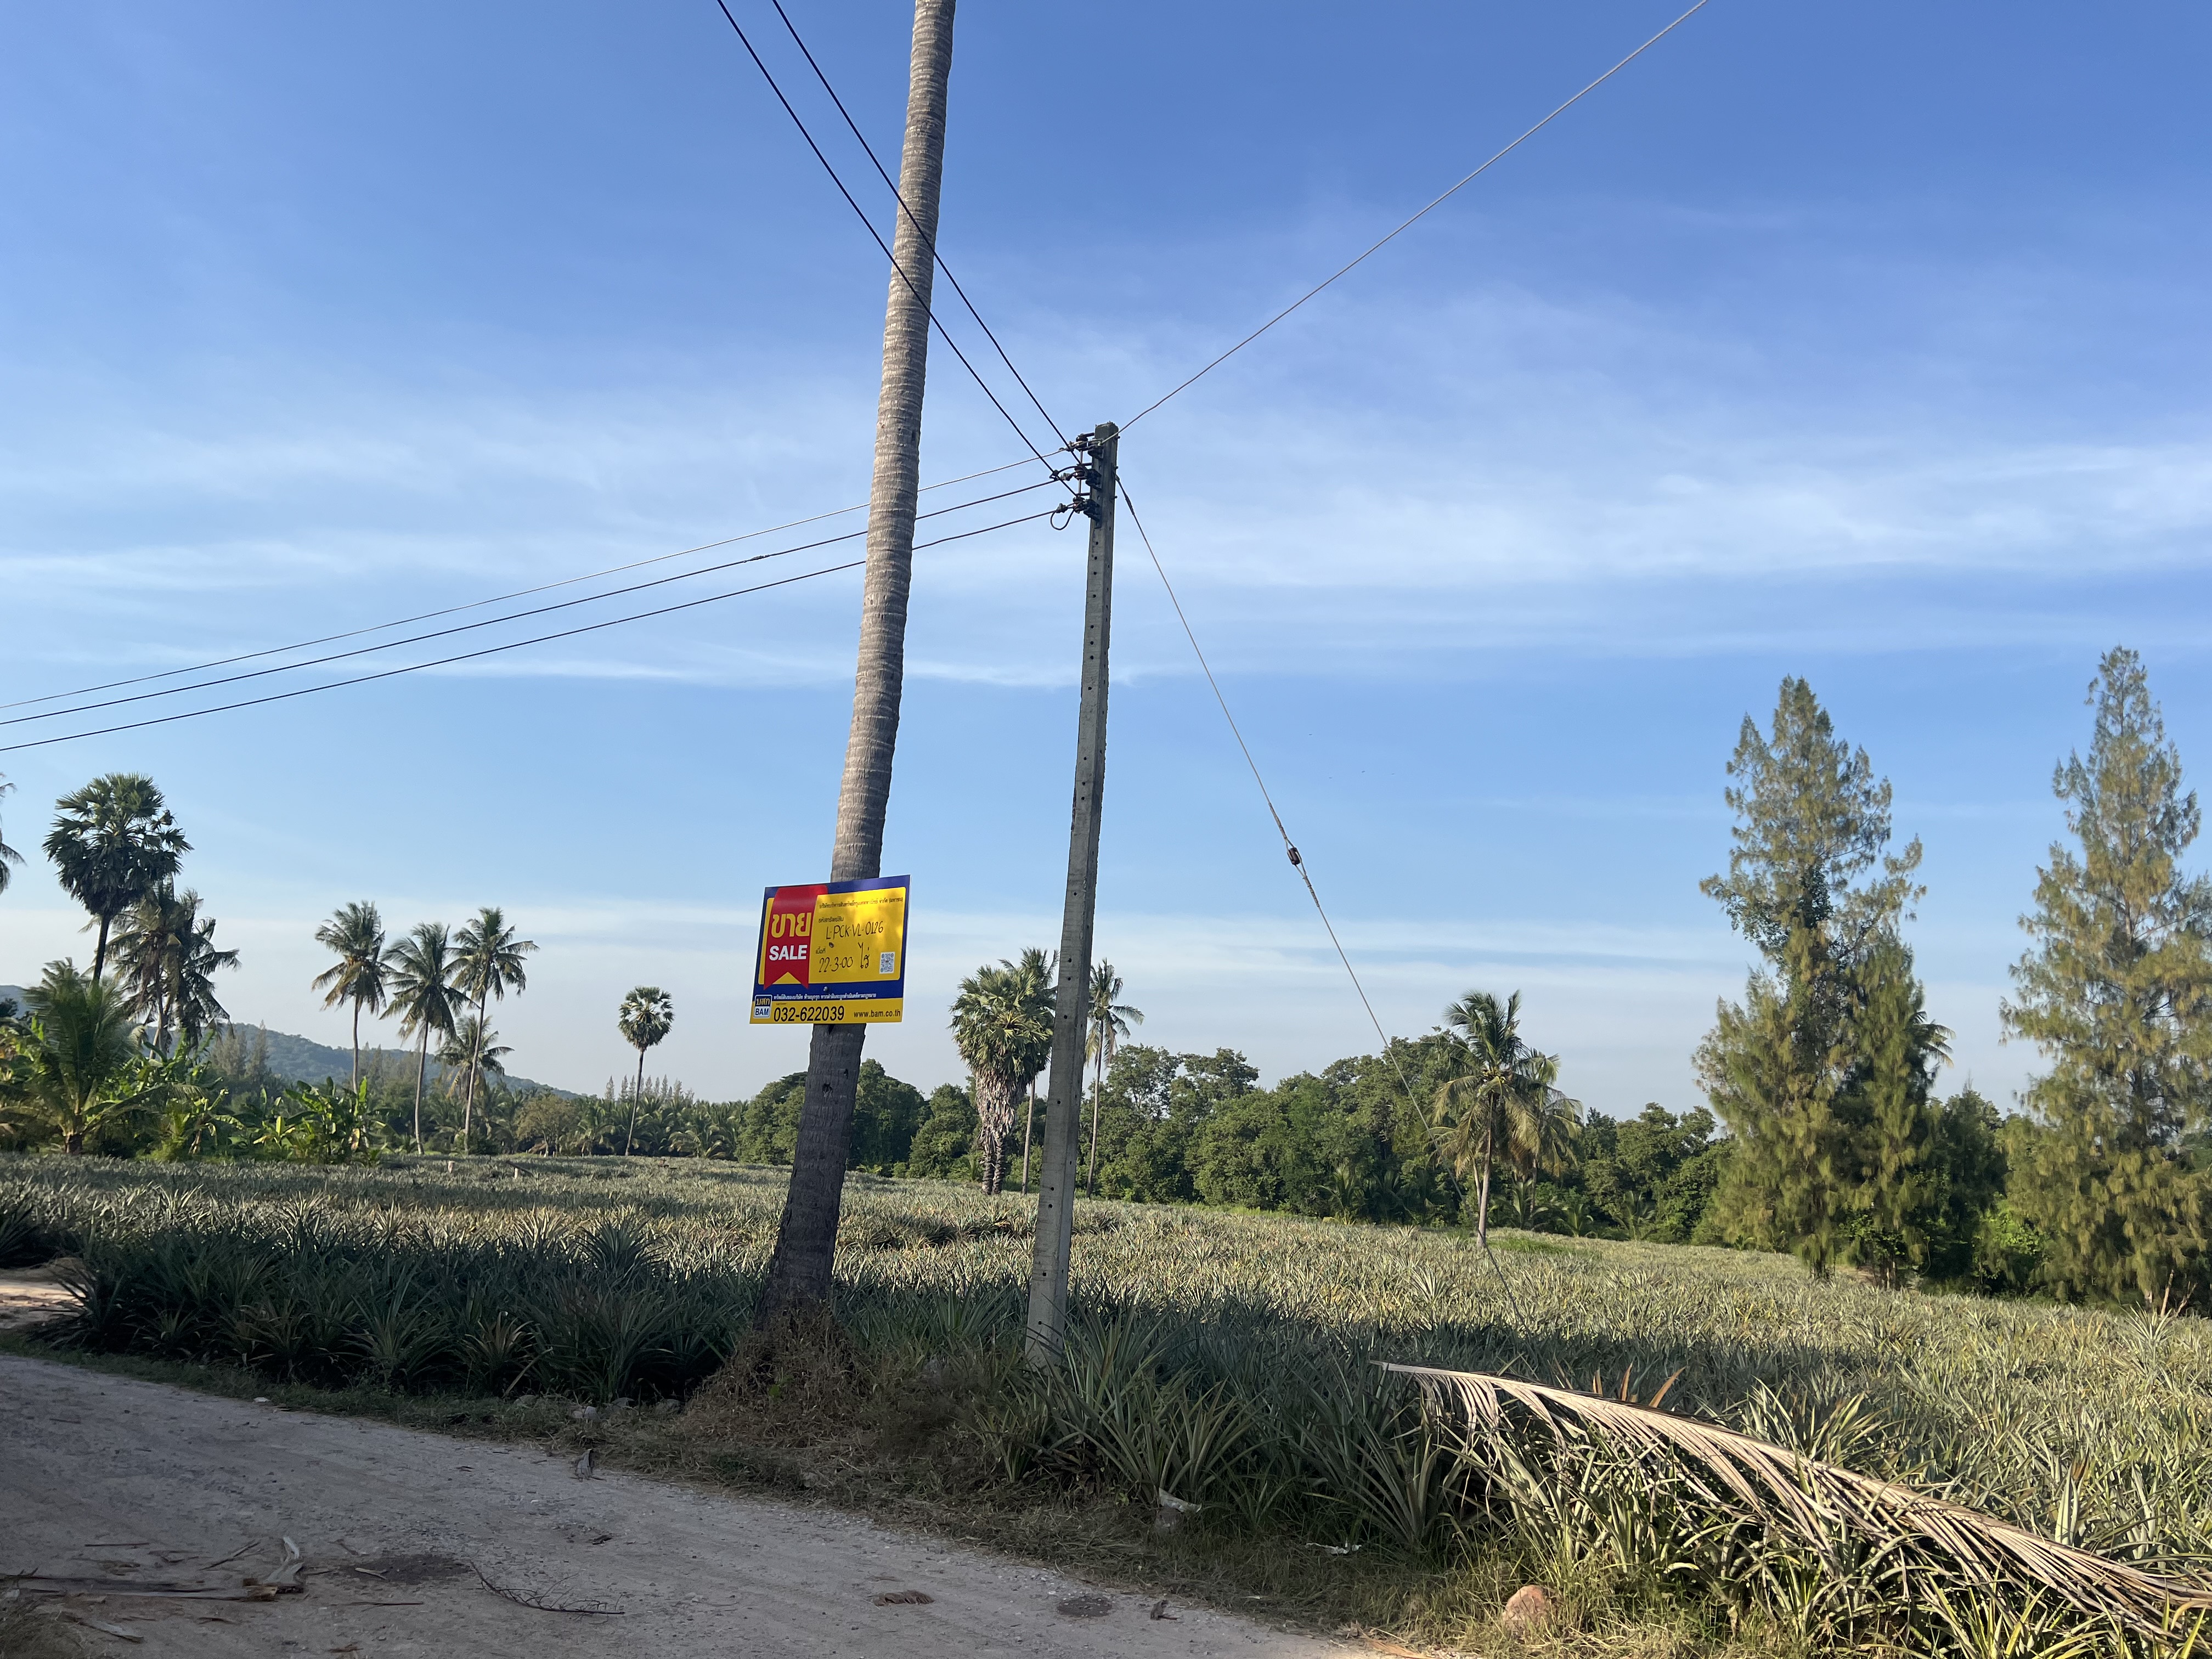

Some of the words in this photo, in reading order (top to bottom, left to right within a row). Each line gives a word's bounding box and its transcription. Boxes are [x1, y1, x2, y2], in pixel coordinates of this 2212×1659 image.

[771, 912, 812, 938] ขาย
[769, 945, 808, 961] SALE
[774, 1006, 844, 1022] 032-622039
[854, 1009, 901, 1018] www.bam.co.th
